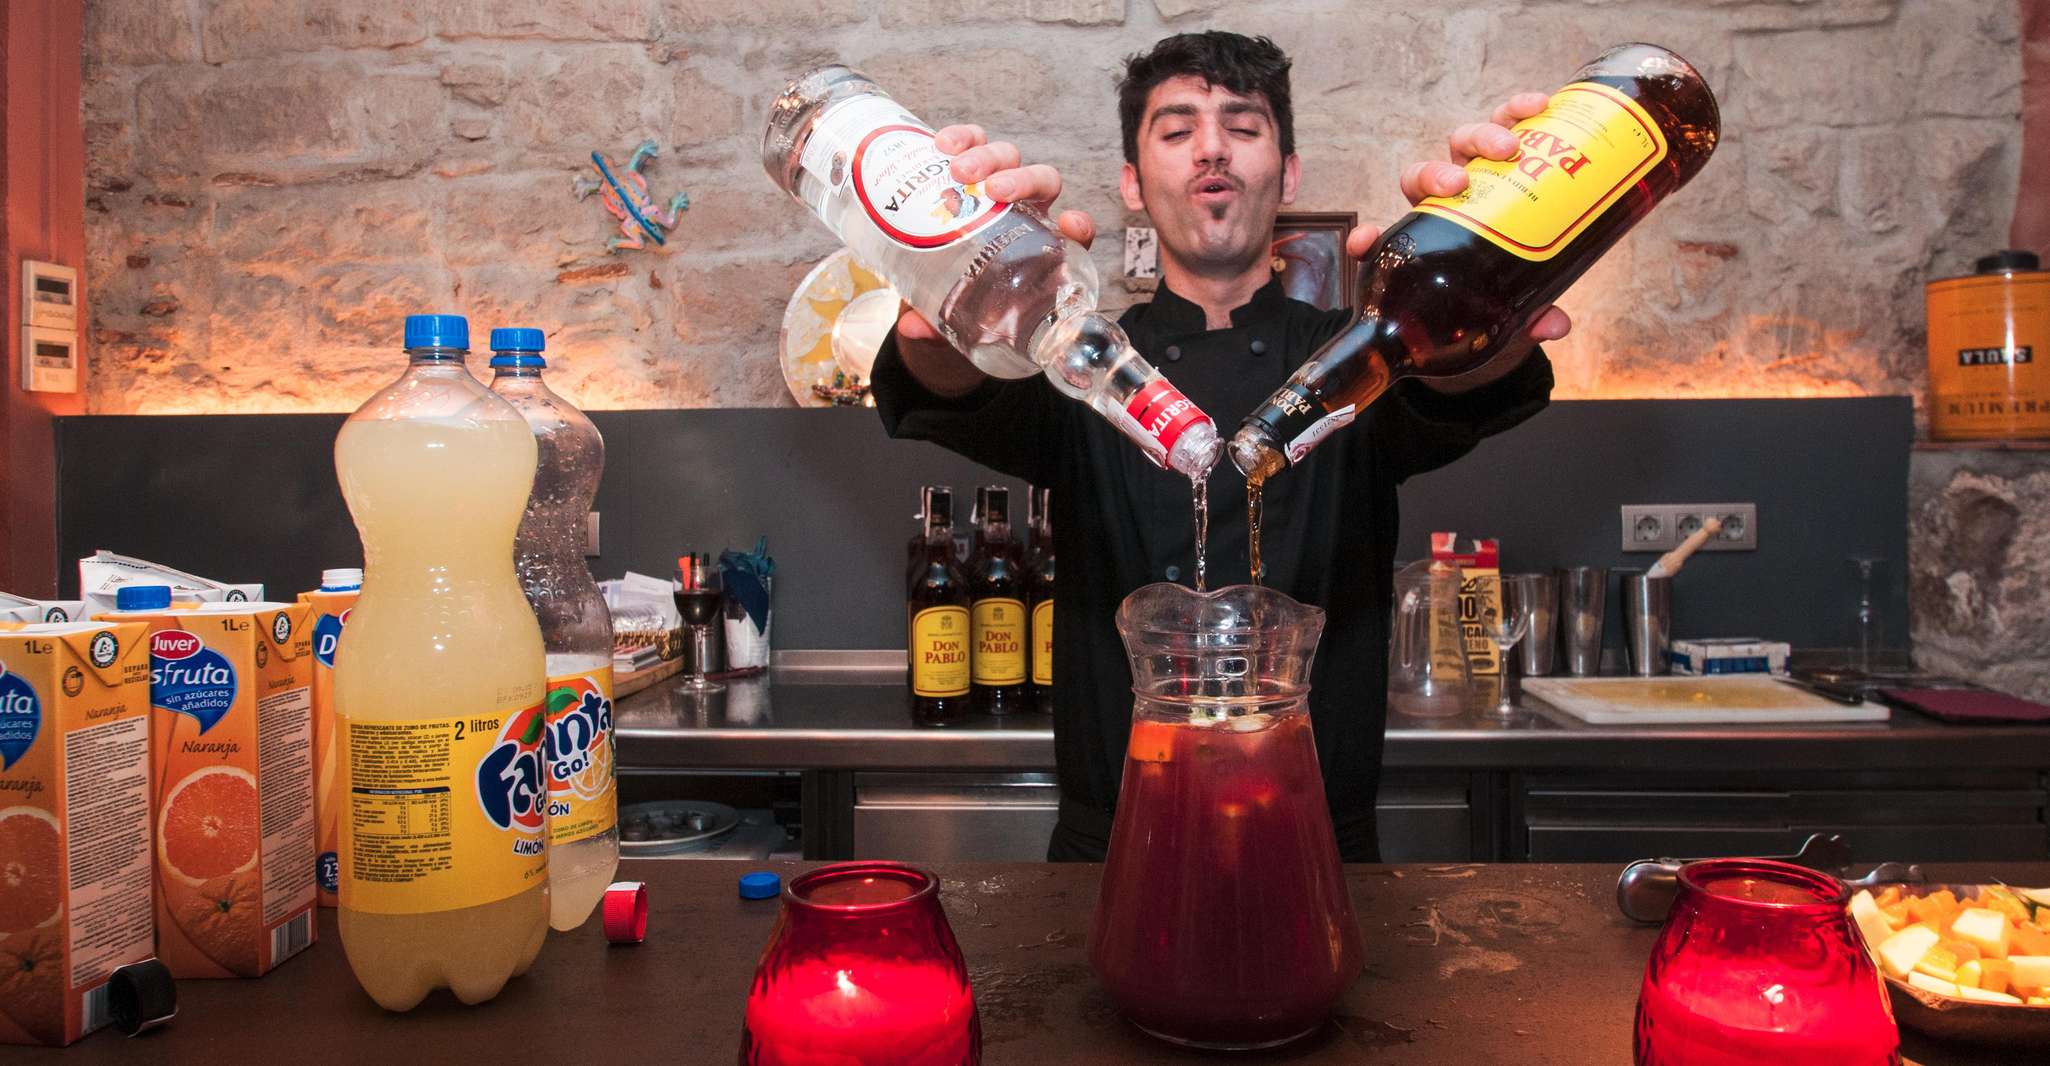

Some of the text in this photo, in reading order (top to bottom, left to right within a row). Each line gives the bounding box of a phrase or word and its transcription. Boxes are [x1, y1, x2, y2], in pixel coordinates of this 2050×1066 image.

[1519, 128, 1592, 180] PABL
[884, 158, 951, 213] GRITA
[1961, 348, 2027, 364] SAULA
[1149, 399, 1195, 440] EGRITA
[152, 636, 195, 651] Juver
[986, 631, 1011, 642] DON
[933, 641, 960, 651] DON
[979, 641, 1019, 653] PABLO
[925, 651, 966, 664] PABLO
[150, 662, 229, 687] sfruta
[166, 689, 229, 704] sin azúcares
[181, 699, 229, 711] añadidos
[454, 719, 499, 741] 2 litros
[182, 739, 240, 760] Naranja
[548, 801, 570, 815] ÓN
